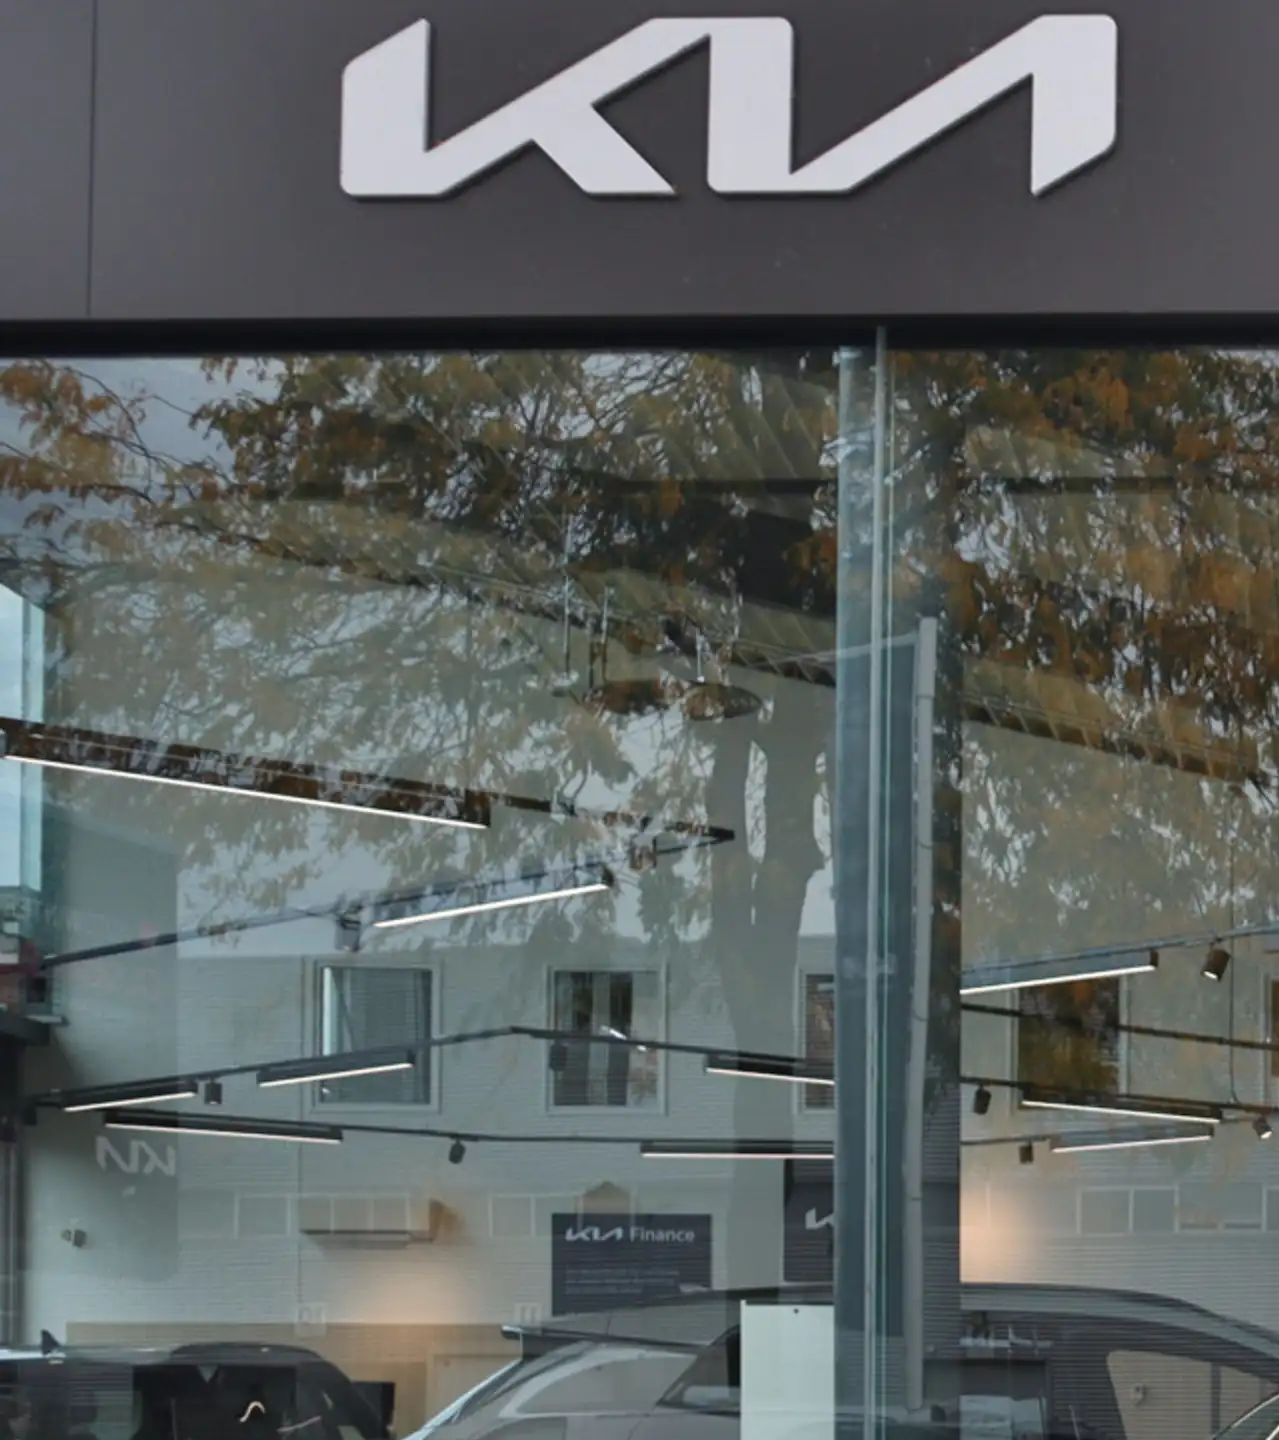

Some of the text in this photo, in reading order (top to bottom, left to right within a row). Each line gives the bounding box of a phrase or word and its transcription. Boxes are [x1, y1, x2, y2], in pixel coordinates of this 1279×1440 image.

[340, 14, 1117, 196] KIA
[565, 1226, 695, 1242] KIA Finance
